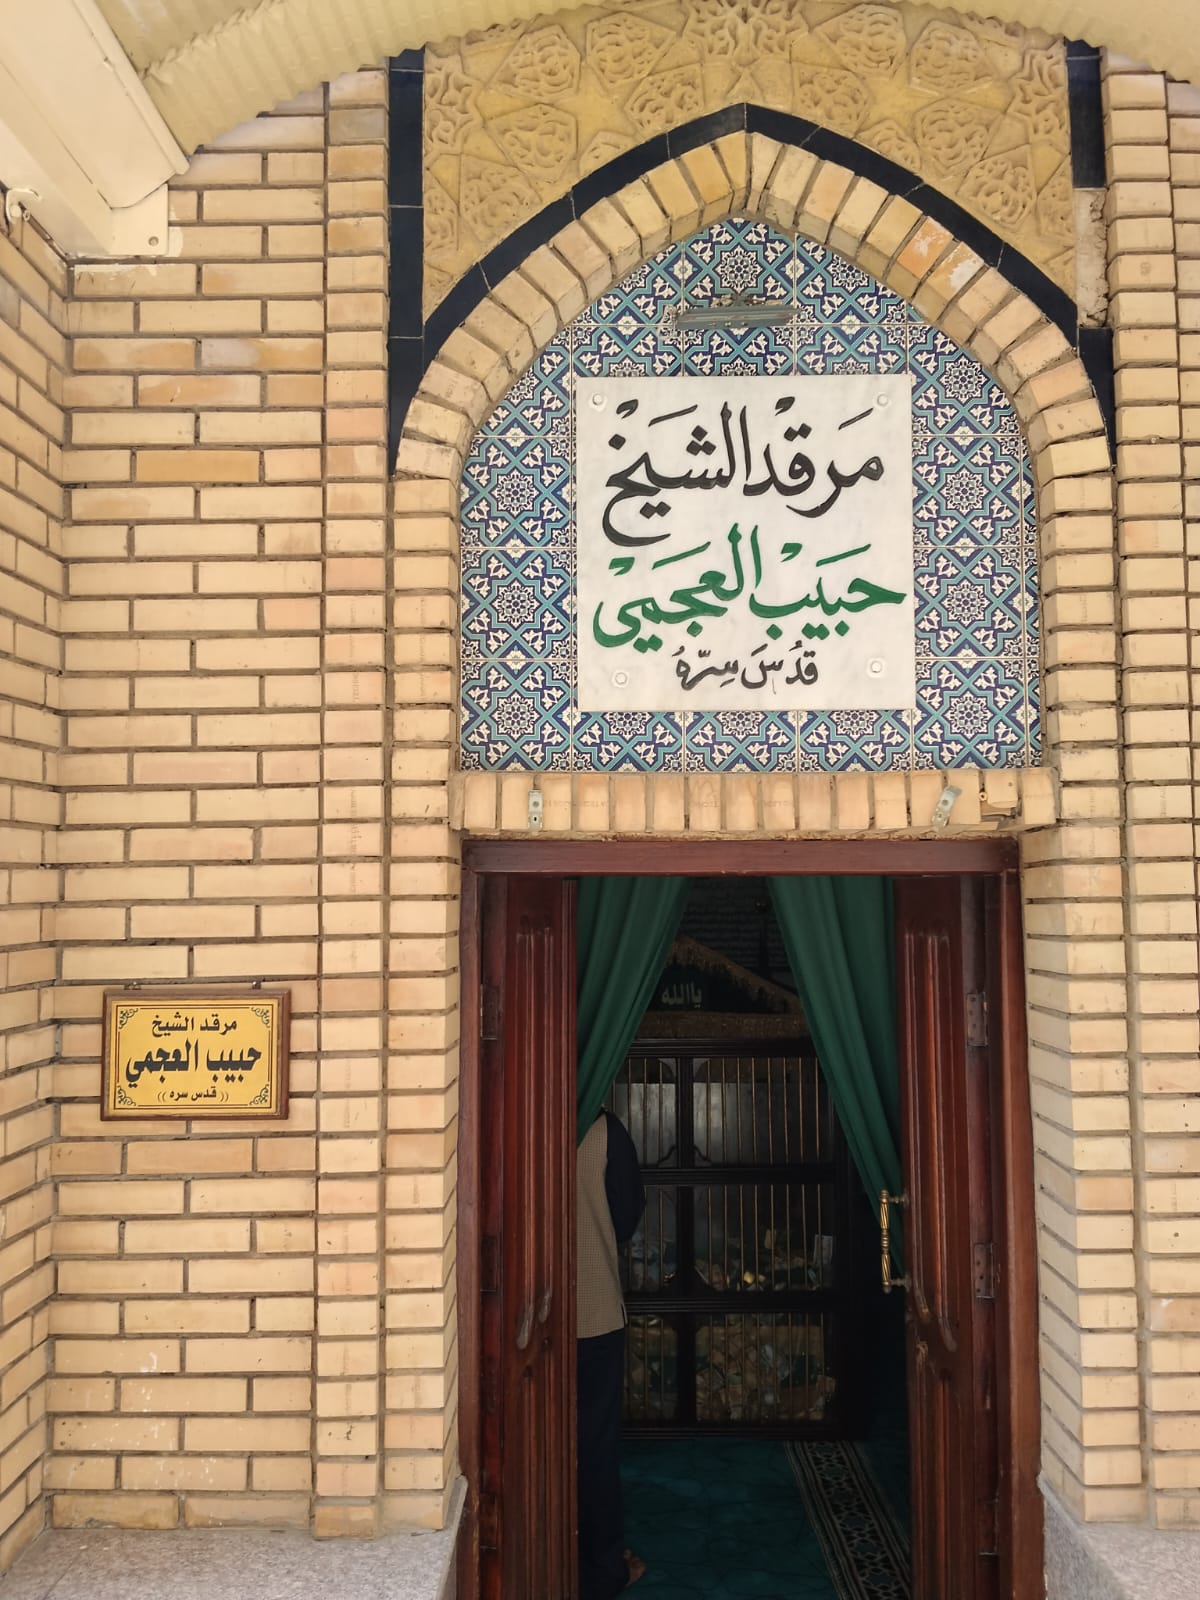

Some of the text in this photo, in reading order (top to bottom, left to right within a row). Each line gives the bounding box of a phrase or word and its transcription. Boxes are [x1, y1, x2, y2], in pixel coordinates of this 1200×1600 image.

[151, 1011, 237, 1038] مرقد الشيخ
[125, 1038, 262, 1088] حبيب العجمي
